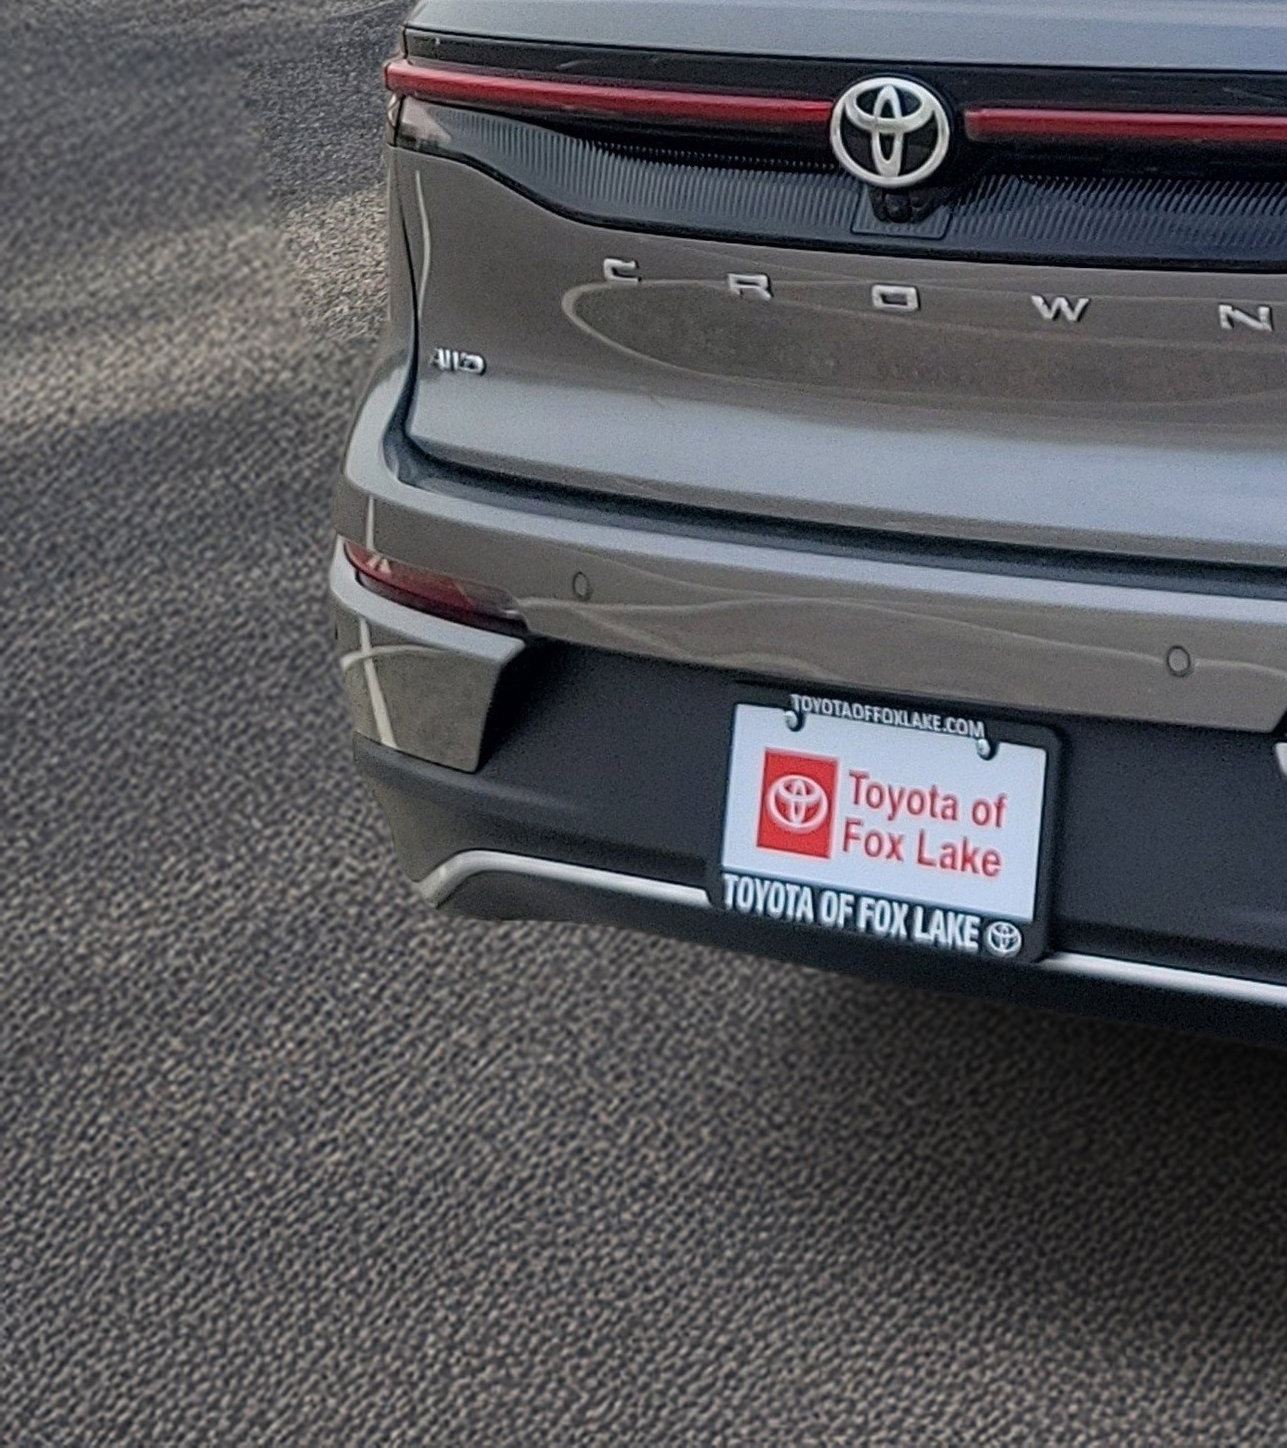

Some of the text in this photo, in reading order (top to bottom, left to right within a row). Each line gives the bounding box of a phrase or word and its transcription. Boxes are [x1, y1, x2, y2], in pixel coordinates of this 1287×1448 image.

[603, 257, 1273, 332] CROWN
[790, 694, 987, 738] TOYOTAOFFOXLAKE.COM
[848, 769, 1008, 829] Toyota of
[843, 817, 1001, 877] Fox Lake
[722, 873, 981, 951] TOYOTA OF FOX LAKE
